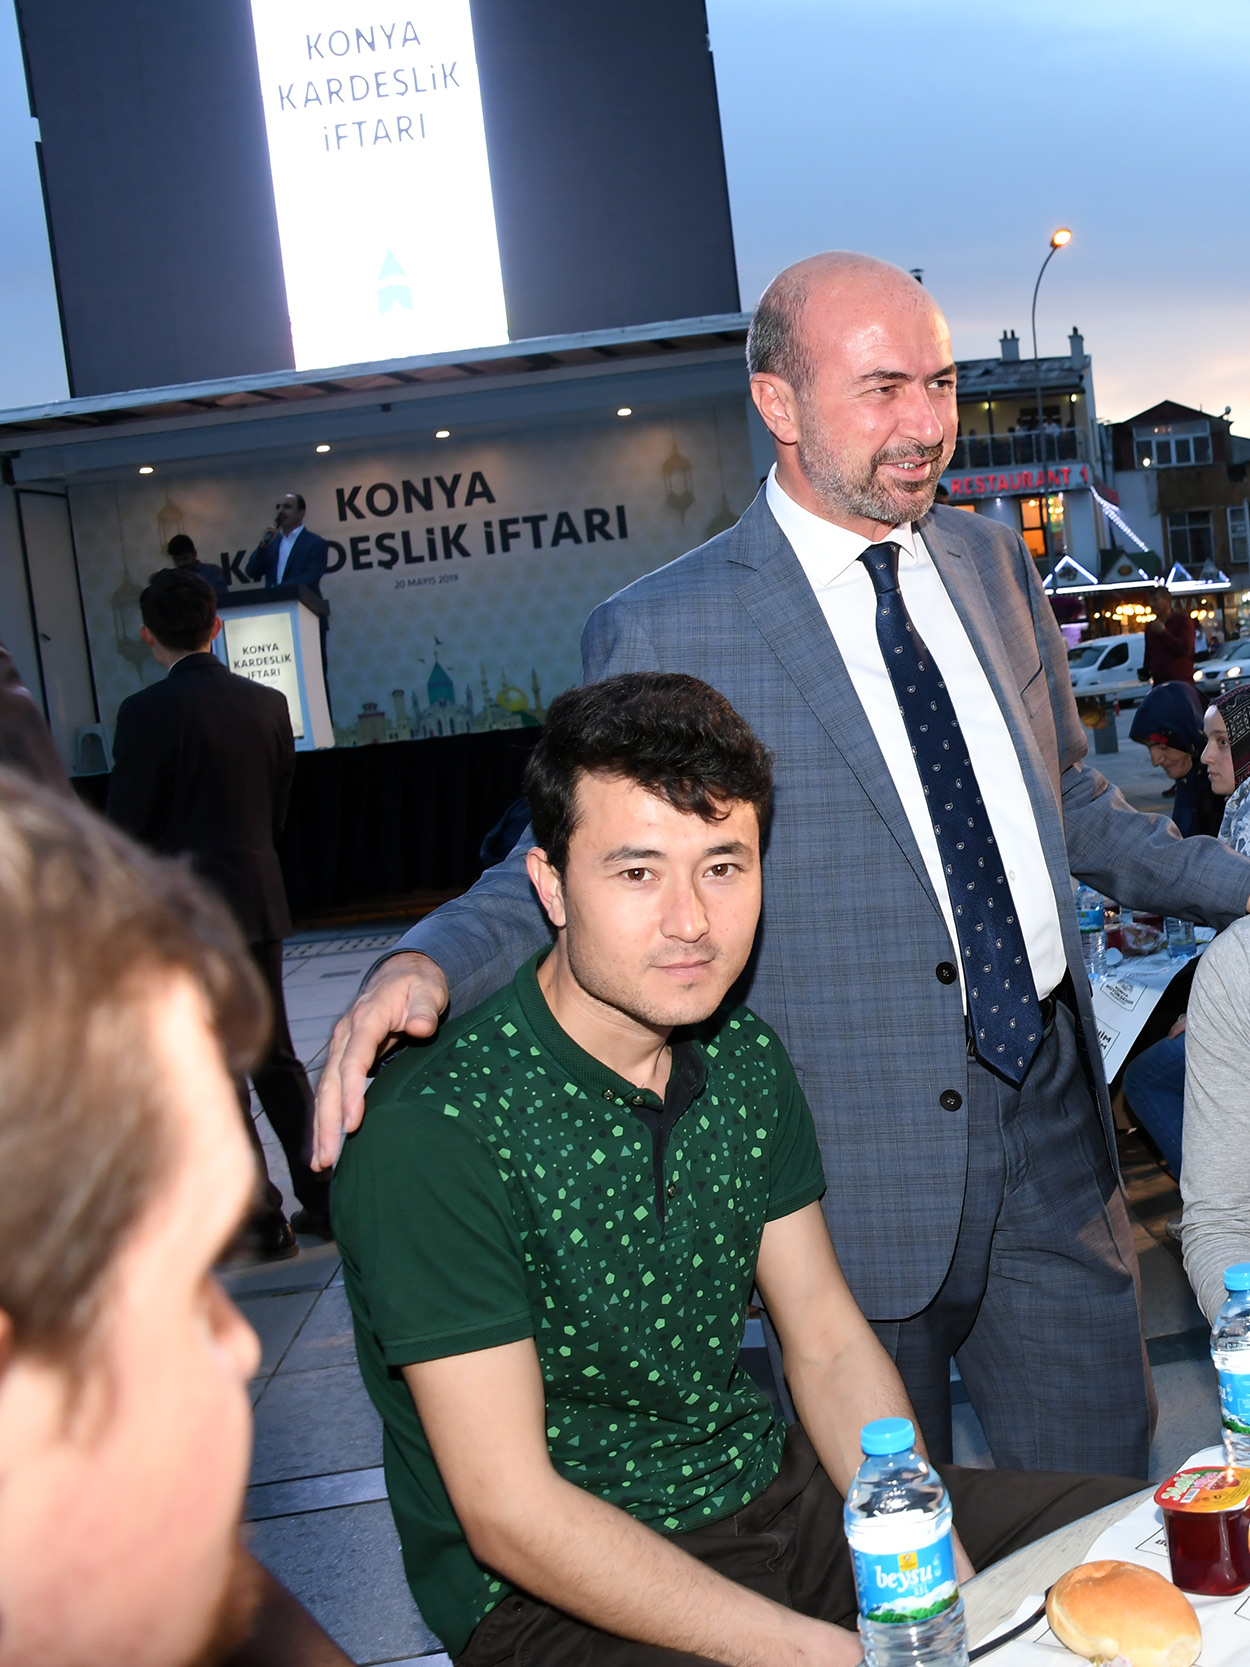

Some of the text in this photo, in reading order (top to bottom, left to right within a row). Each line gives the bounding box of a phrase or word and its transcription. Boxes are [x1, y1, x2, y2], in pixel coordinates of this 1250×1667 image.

[306, 21, 421, 60] KONYA
[951, 467, 1071, 495] RESTAURANT
[335, 471, 496, 522] KONYA
[395, 580, 406, 589] 20
[439, 574, 459, 585] 2019
[242, 643, 279, 655] KONYA
[875, 1564, 933, 1593] beysu
